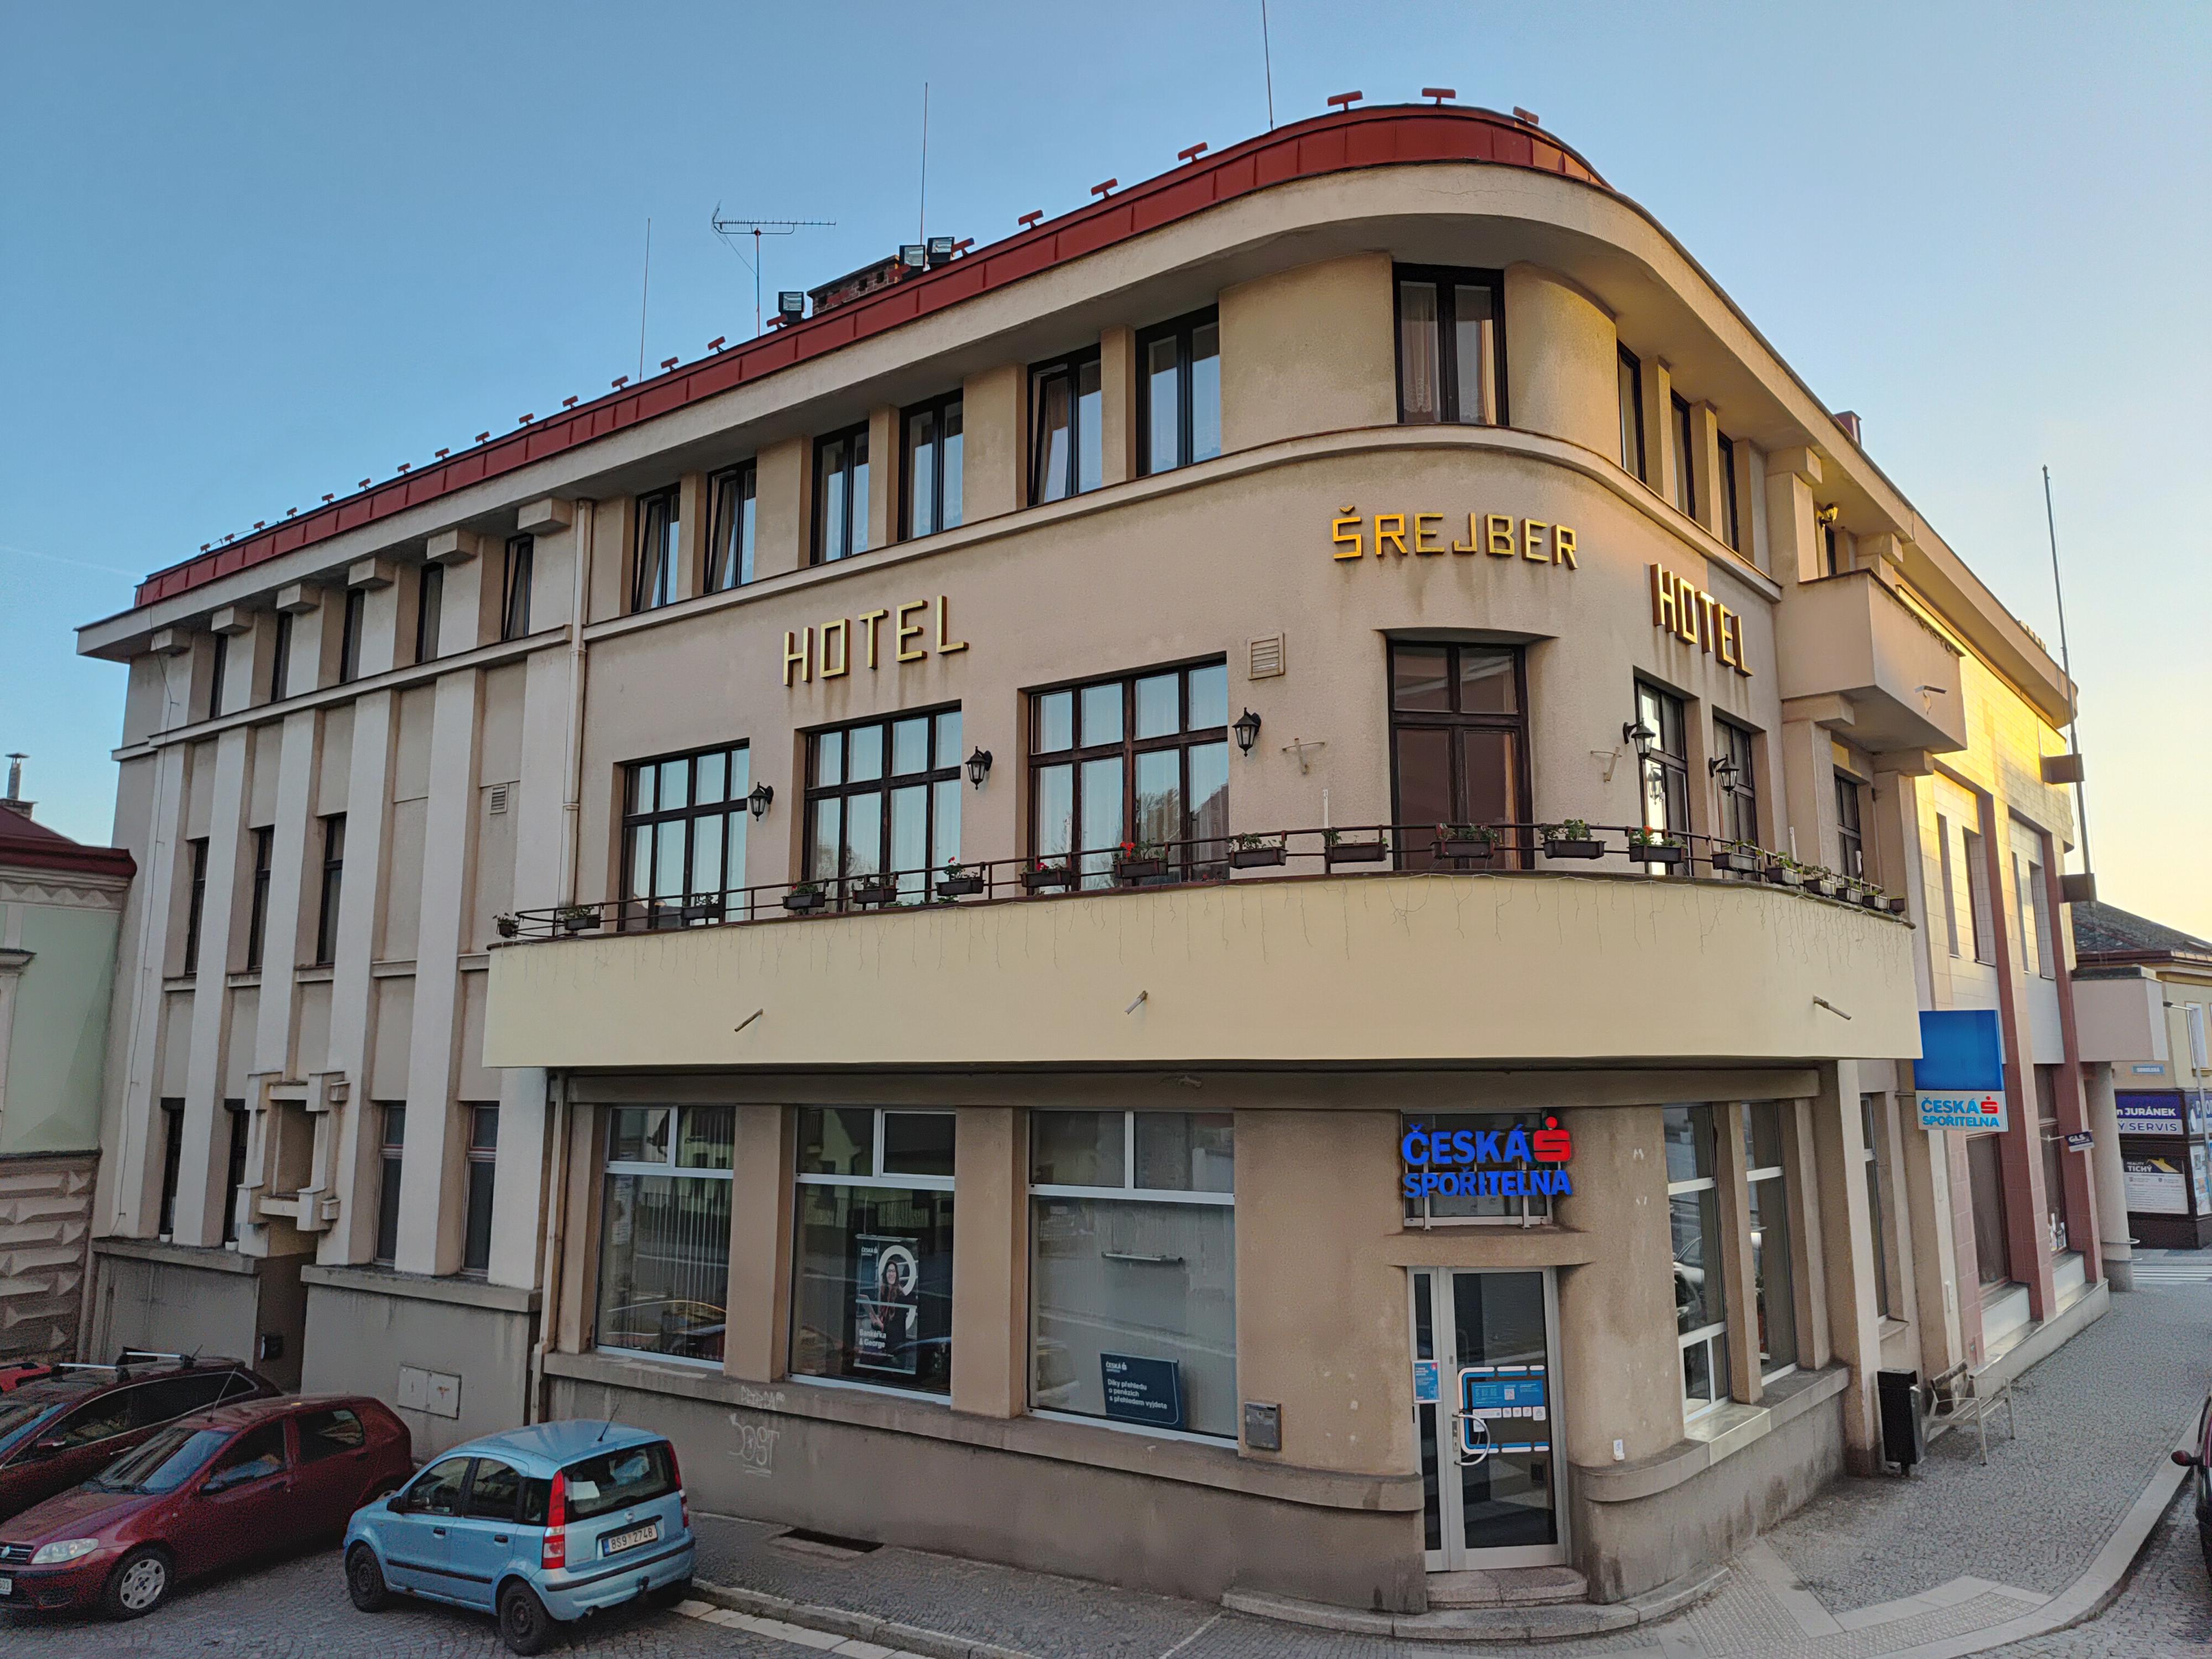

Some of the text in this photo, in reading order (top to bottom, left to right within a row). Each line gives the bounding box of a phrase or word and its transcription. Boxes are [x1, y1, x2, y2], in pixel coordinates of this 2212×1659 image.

[1332, 505, 1578, 570] ŠREJBER
[1650, 562, 1754, 677] HOTEL
[783, 595, 969, 687] HOTEL
[1921, 1097, 1979, 1114] ČESKÁ
[2125, 1106, 2176, 1116] JURÁNEK
[1922, 1114, 2000, 1127] SPOŘITELNA
[2129, 1123, 2177, 1131] SERVIS
[2069, 1134, 2085, 1142] GLS
[1402, 1124, 1532, 1166] ČESKÁ
[1404, 1166, 1573, 1197] SPOŘITELNA
[864, 1338, 885, 1349] George
[1105, 1361, 1121, 1369] ČESKÁ
[1121, 1381, 1147, 1390] přehledu
[1114, 1396, 1145, 1406] přehledem
[1145, 1401, 1167, 1409] vyjdete
[611, 1527, 653, 1549] 8S9 2748
